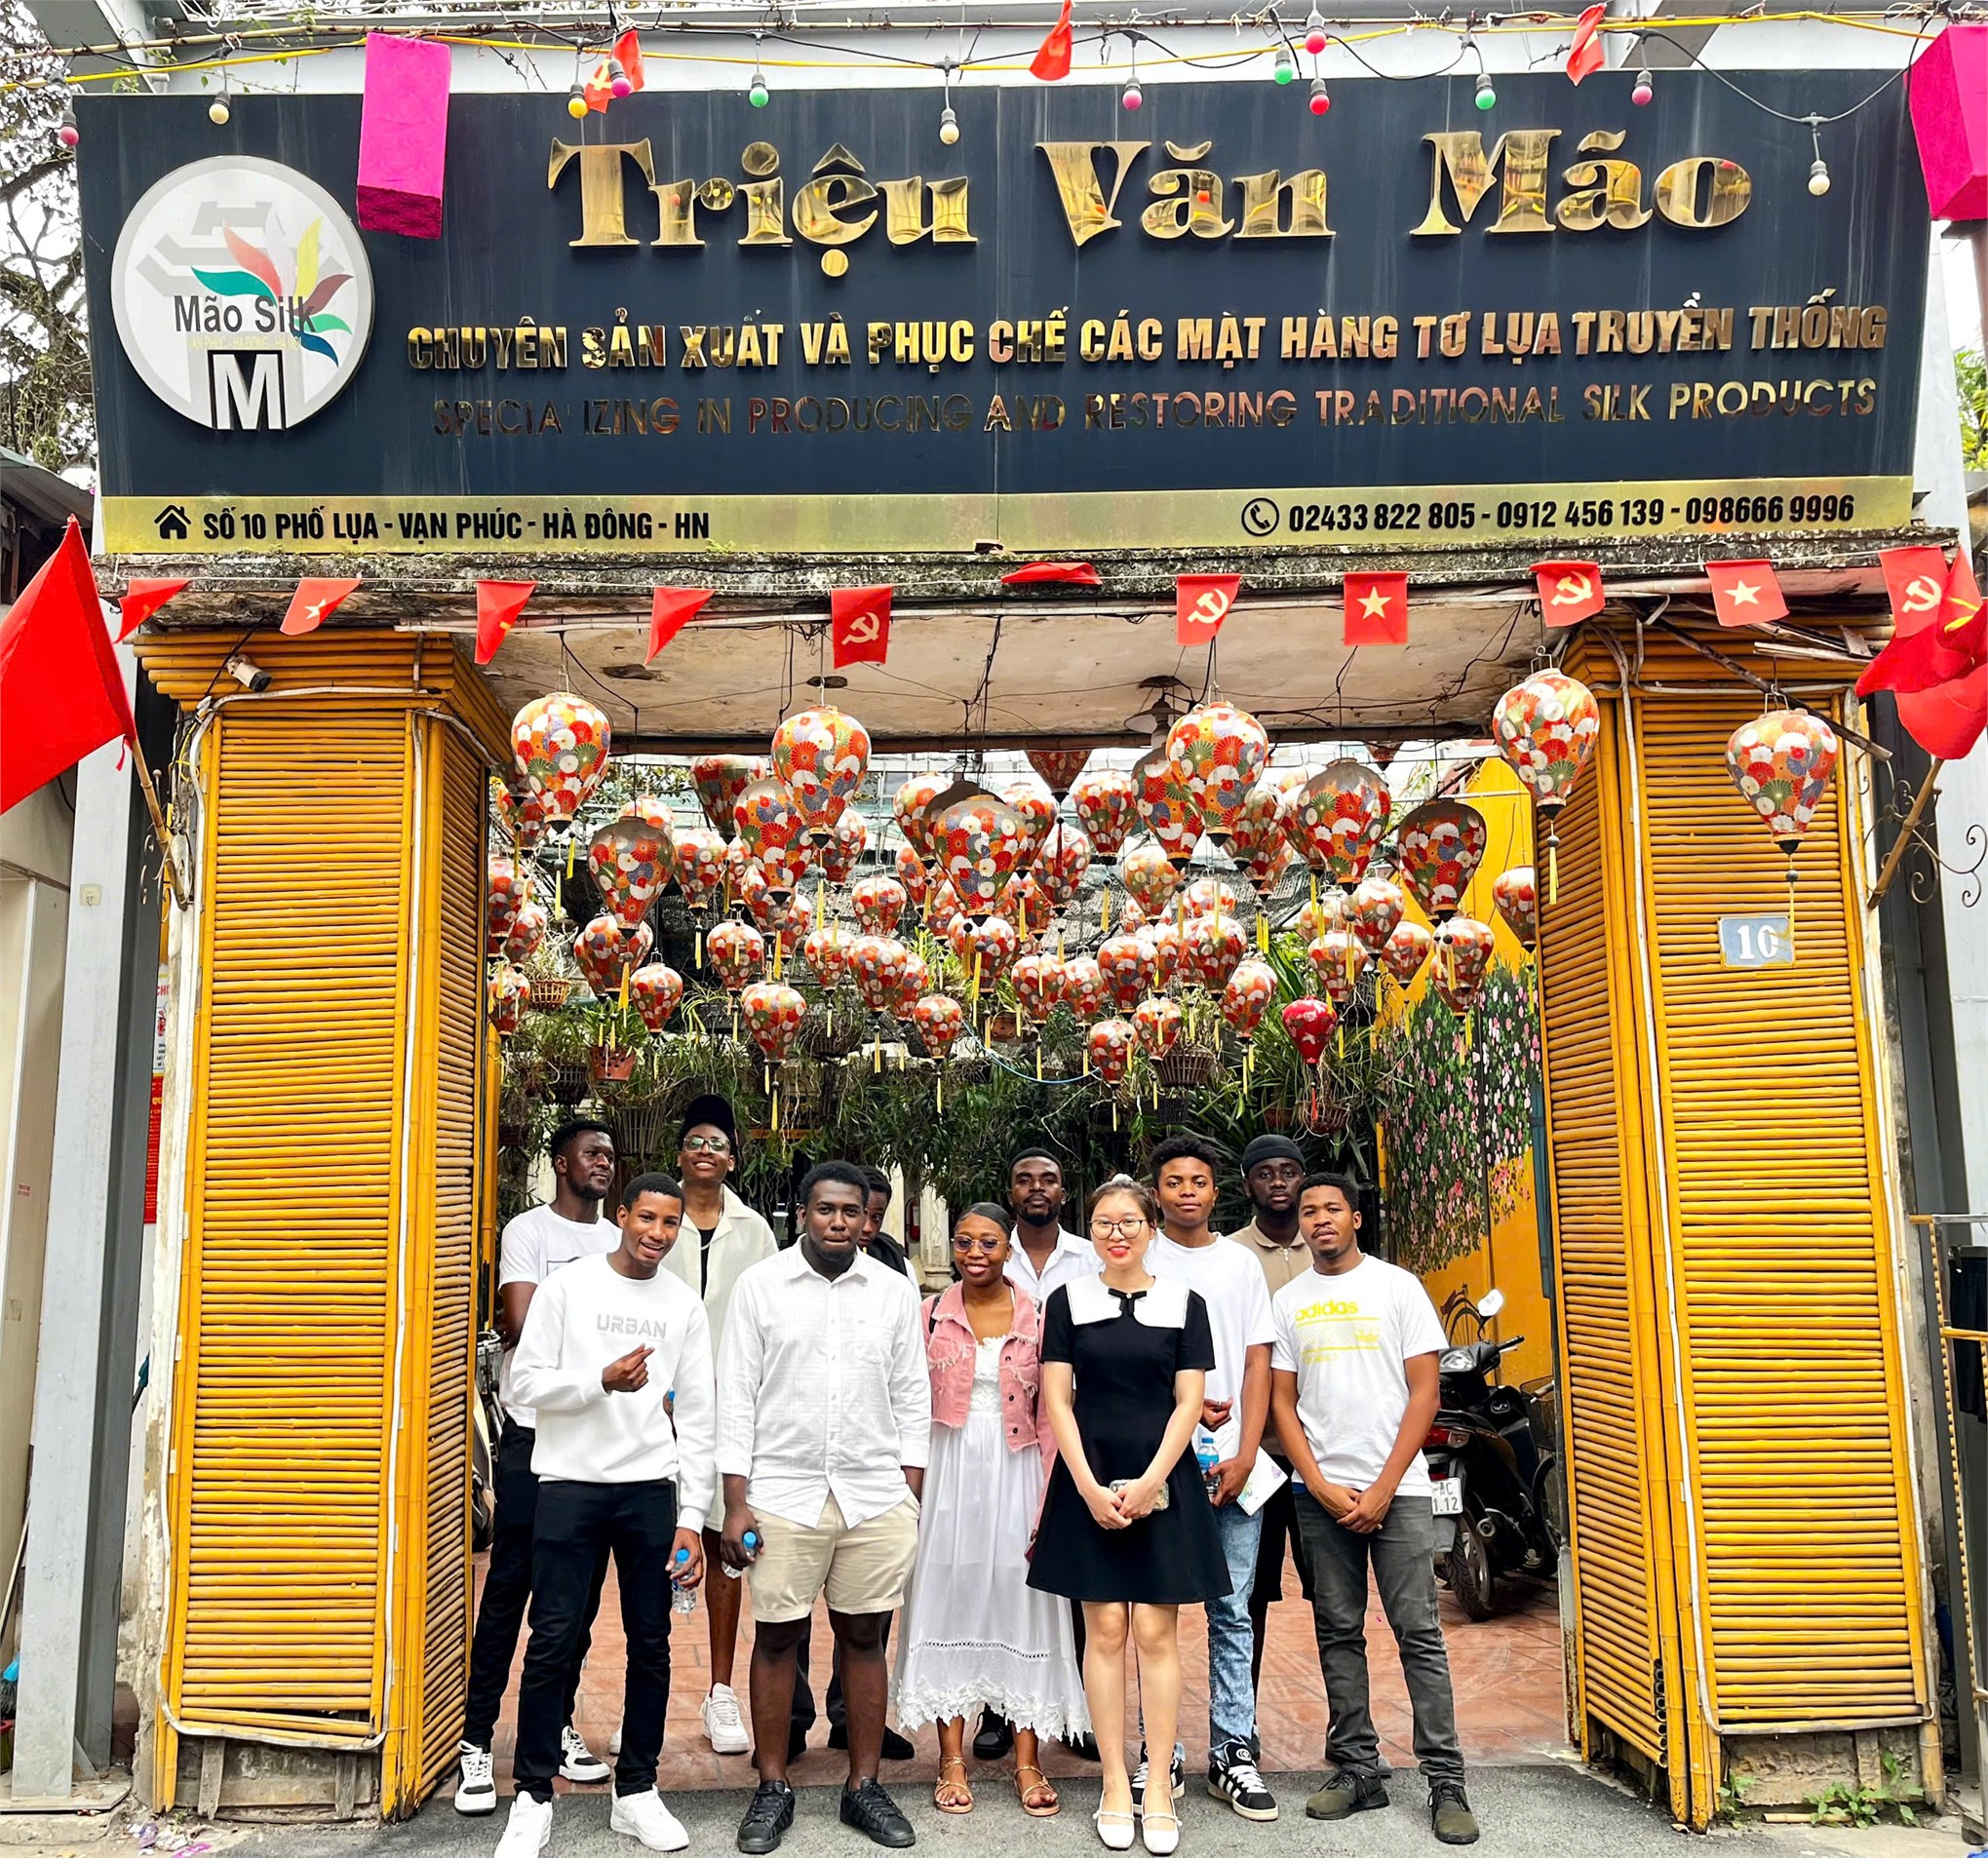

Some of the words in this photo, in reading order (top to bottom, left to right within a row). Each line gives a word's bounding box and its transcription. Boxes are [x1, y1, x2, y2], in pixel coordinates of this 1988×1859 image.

[547, 137, 978, 277] Triệu
[1034, 140, 1337, 247] Văn
[1409, 129, 1753, 235] Mão
[174, 295, 243, 332] Mão
[254, 295, 317, 333] Silk
[408, 316, 567, 369] CHUYÊN
[582, 307, 666, 368] SẢN
[800, 312, 851, 365] VÀ
[867, 320, 975, 373] PHỤC
[989, 306, 1070, 363] CHẾ
[1079, 309, 1163, 362] CÁC
[1280, 308, 1399, 359] HÀNG
[1413, 311, 1471, 359] TƠ
[1481, 312, 1562, 365] LỤA
[1571, 291, 1735, 355] TRUYỀN
[1748, 288, 1888, 349] THỐNG
[697, 397, 730, 434] IN
[748, 394, 974, 434] PRODUCING
[983, 394, 1066, 432] AND
[1084, 390, 1298, 430] RESTORING
[1315, 386, 1565, 427] TRADITIONAL
[1582, 383, 1654, 422] SILK
[1668, 377, 1877, 420] PRODUCTS
[203, 507, 237, 539] SỐ
[241, 513, 266, 539] 10
[276, 505, 326, 539] PHỐ
[333, 513, 378, 544] LỤA
[398, 513, 447, 544] VẠN
[456, 507, 522, 539] PHÚC
[543, 507, 577, 539] HÀ
[585, 508, 652, 539] ĐÔNG
[675, 513, 709, 539] HN
[1289, 504, 1368, 531] 02433
[1374, 503, 1421, 529] 822
[1428, 502, 1475, 528] 805
[1497, 501, 1557, 527] 0912
[1565, 500, 1613, 526] 456
[1620, 499, 1663, 526] 139
[1686, 496, 1783, 523] 098666
[1789, 495, 1854, 522] 9996
[1736, 924, 1779, 960] 10
[596, 1313, 667, 1339] URBAN
[1295, 1299, 1358, 1322] adidas
